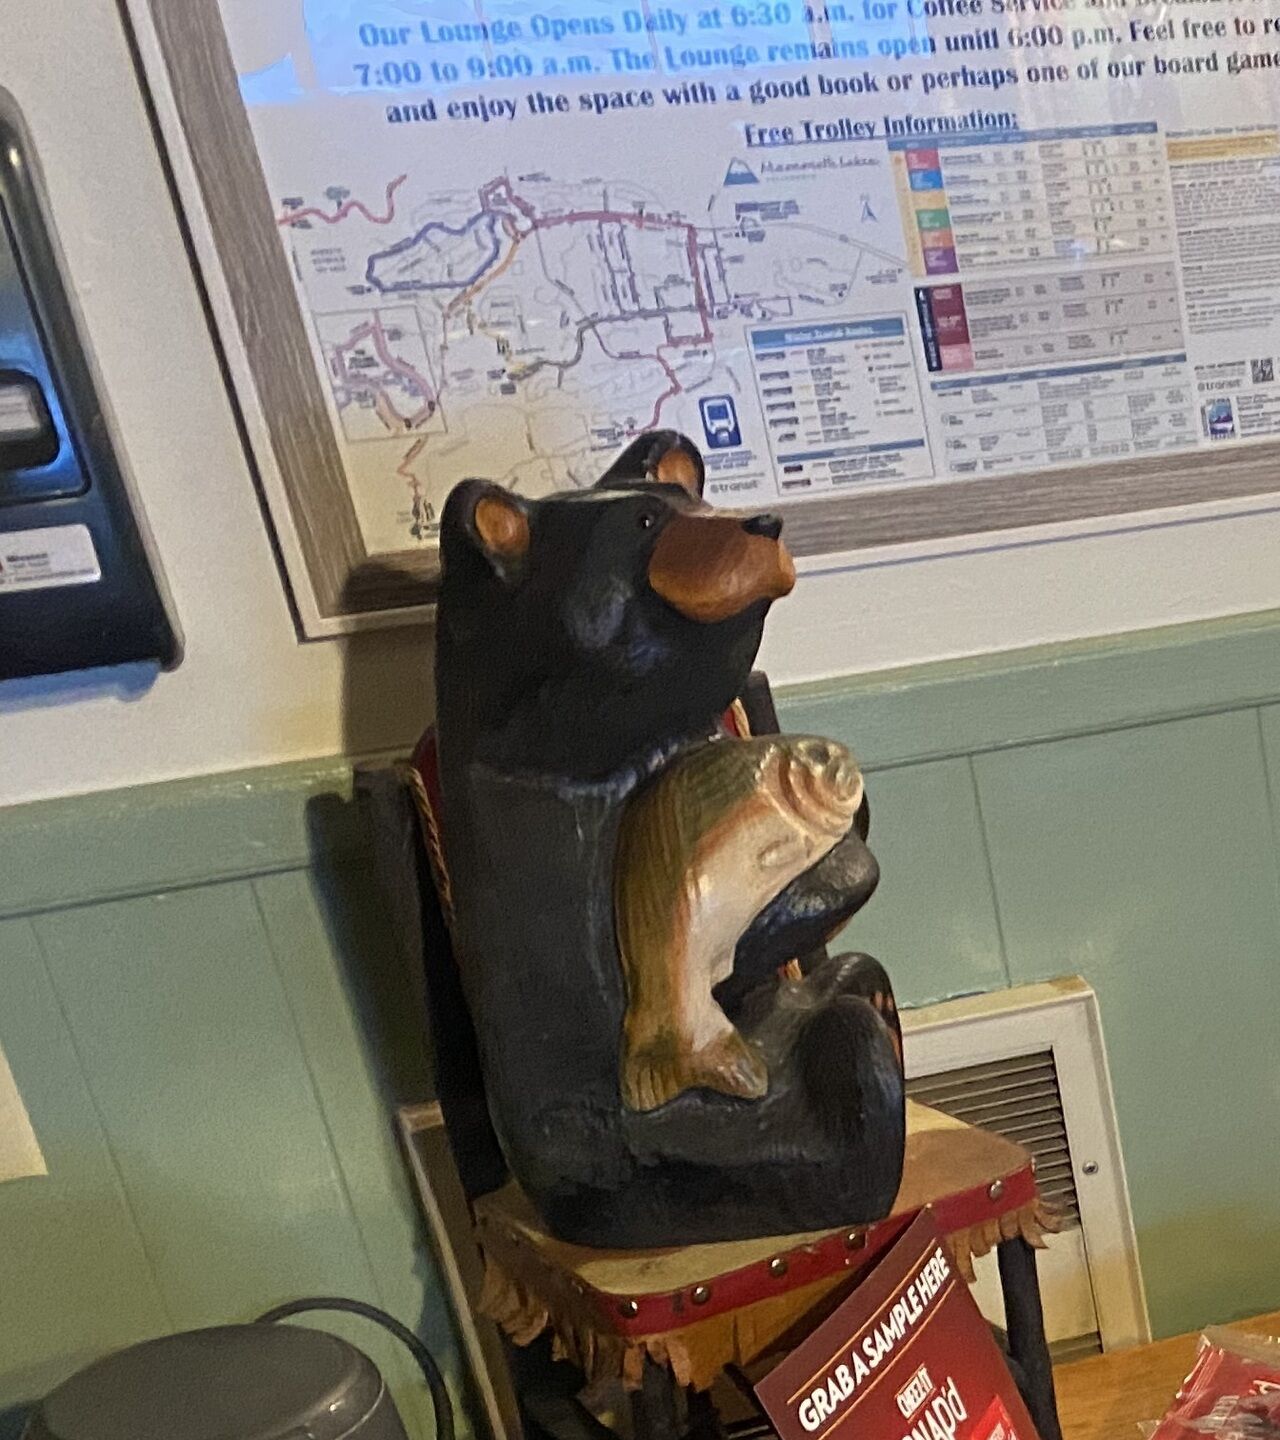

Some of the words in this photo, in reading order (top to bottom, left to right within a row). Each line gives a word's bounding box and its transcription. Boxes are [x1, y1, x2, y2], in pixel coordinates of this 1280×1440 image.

[353, 61, 421, 86] 7:00
[431, 59, 458, 83] to
[466, 53, 533, 78] 9:00
[543, 53, 600, 76] a.m.
[610, 47, 655, 71] The
[664, 44, 758, 71] Lounge
[767, 39, 868, 63] remains
[877, 37, 936, 60] open
[1008, 24, 1064, 48] 6:00
[1129, 19, 1175, 42] Feel
[1182, 17, 1227, 39] free
[1234, 17, 1255, 36] to
[358, 22, 411, 47] Our
[420, 20, 522, 45] Lounge
[530, 14, 615, 41] Opens
[623, 7, 688, 36] Daily
[697, 6, 723, 30] at
[730, 2, 791, 26] 6:30
[803, 3, 854, 23] a.m.
[862, 1, 896, 20] for
[907, 0, 982, 18] Coffee
[386, 98, 437, 124] and
[446, 95, 517, 122] enjoy
[526, 90, 570, 115] the
[578, 89, 655, 115] space
[662, 80, 717, 106] with
[725, 83, 742, 102] a
[750, 75, 810, 105] good
[818, 71, 879, 96] book
[887, 73, 913, 92] or
[921, 65, 1019, 95] perhaps
[1027, 64, 1069, 84] one
[1077, 58, 1098, 80] of
[1107, 57, 1146, 79] our
[1154, 52, 1219, 75] board
[745, 121, 794, 146] Free
[801, 115, 877, 140] Trolley
[884, 109, 1019, 137] Information:
[798, 1364, 855, 1432] GRAB
[852, 1351, 871, 1386] A
[862, 1284, 924, 1369] SAMPLE
[916, 1246, 951, 1306] HERE
